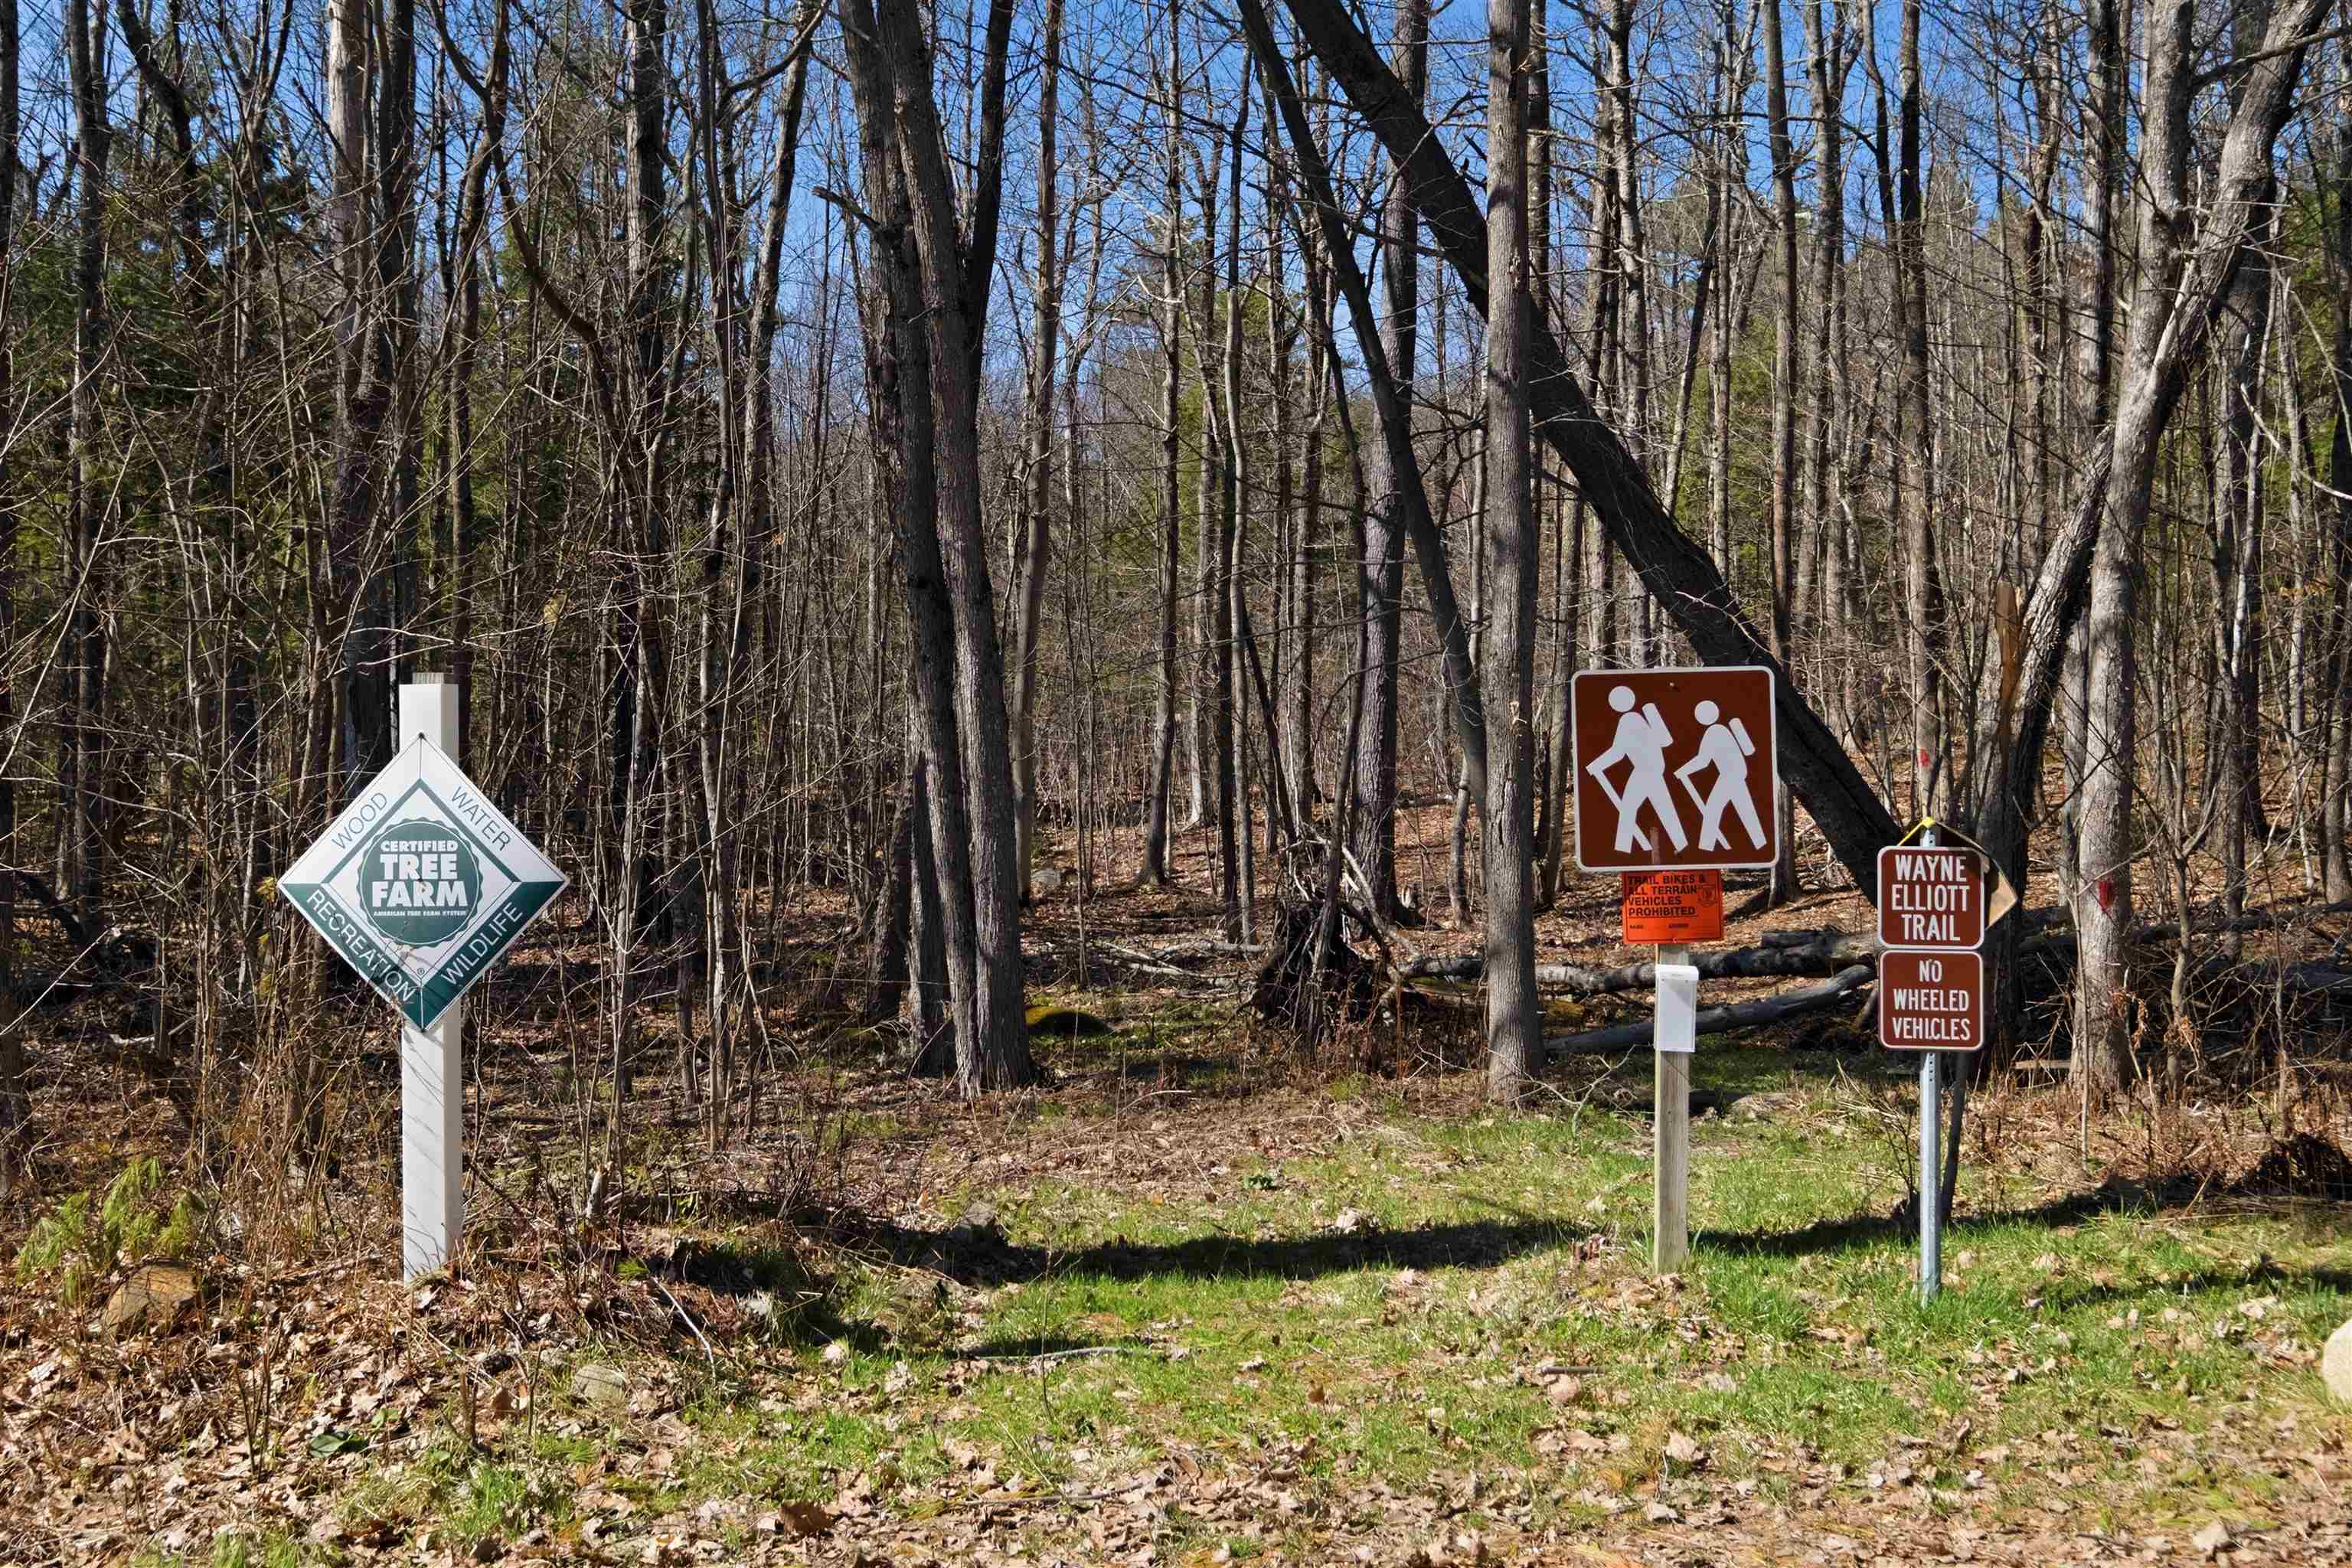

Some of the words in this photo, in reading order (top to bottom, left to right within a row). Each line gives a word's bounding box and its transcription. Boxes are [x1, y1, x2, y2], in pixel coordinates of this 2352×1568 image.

[332, 792, 388, 851] WOOD
[449, 786, 511, 851] WATER
[380, 840, 459, 852] CERTIFIED
[380, 854, 458, 880] TREE
[1628, 875, 1659, 885] TRAIL
[1662, 874, 1695, 884] BIKES
[1894, 854, 1967, 882] WAYNE
[372, 881, 468, 907] FARM
[1628, 896, 1682, 906] VEHICLES
[1651, 885, 1697, 895] TERRAIN
[1892, 884, 1971, 912] ELLIOTT
[1628, 906, 1696, 916] PROHIBITED
[1901, 914, 1961, 942] TRAIL
[306, 889, 418, 1003] RECREATION
[440, 901, 523, 986] WILDLIFE
[1919, 959, 1943, 983] NO
[1893, 988, 1969, 1012] WHEELED
[1892, 1017, 1971, 1041] VEHICLES
